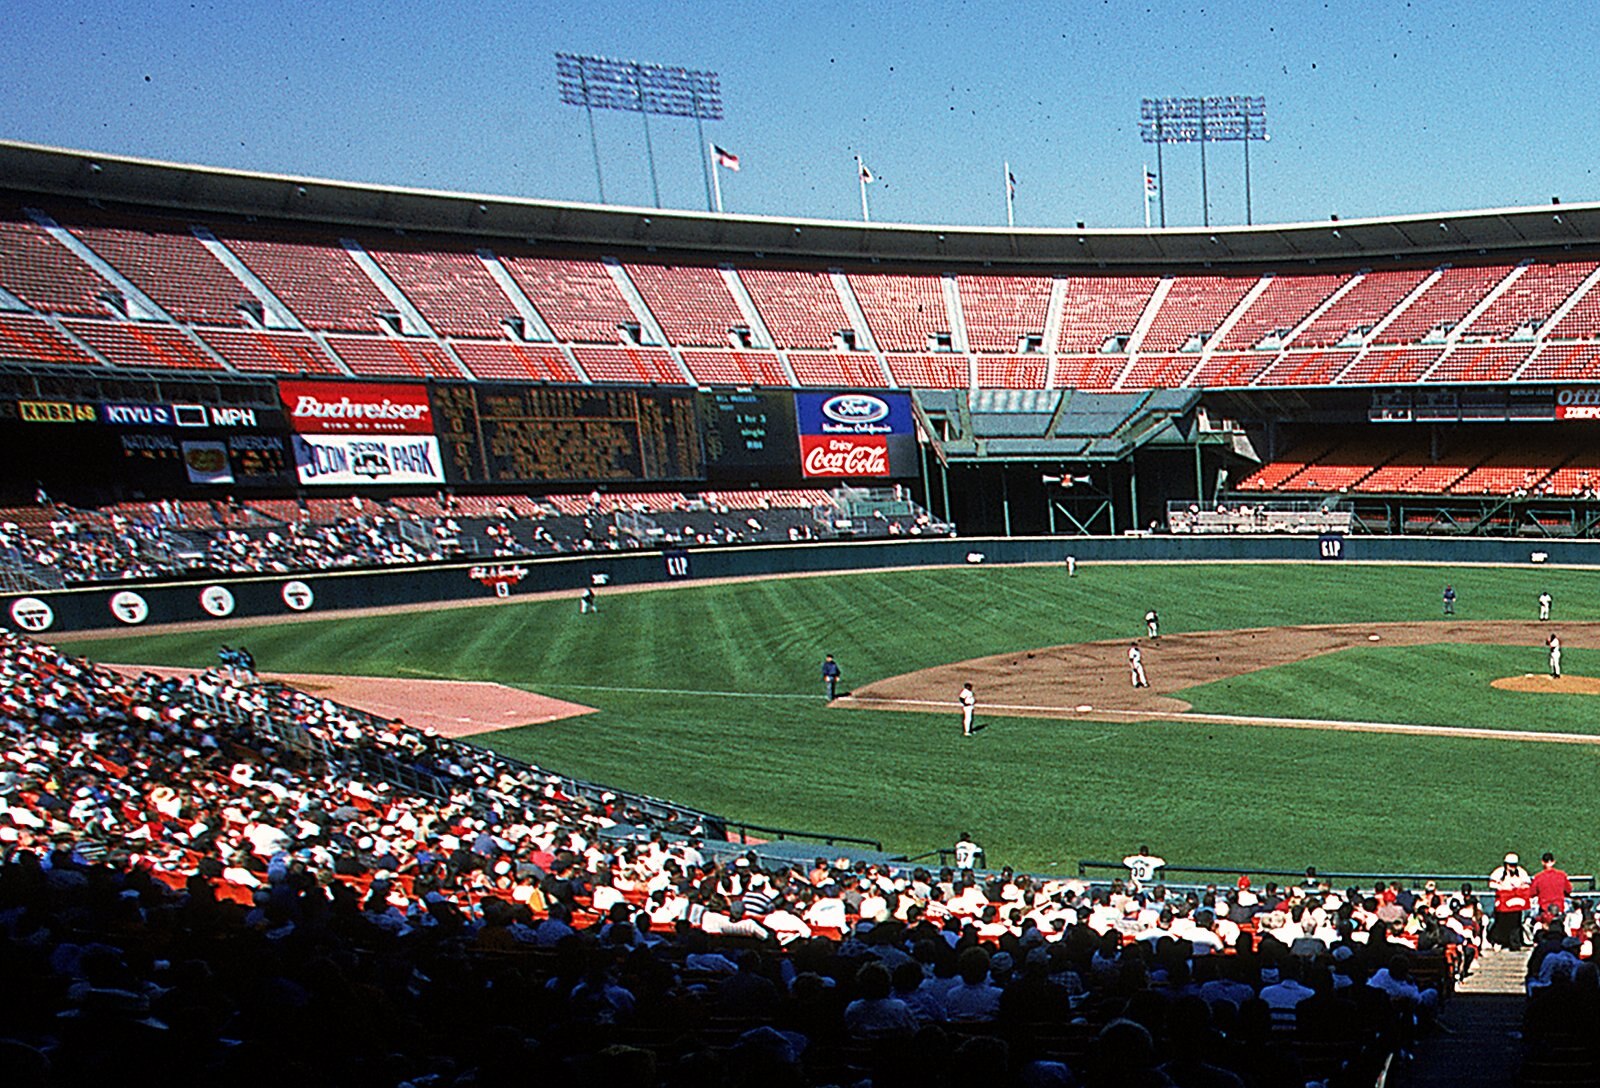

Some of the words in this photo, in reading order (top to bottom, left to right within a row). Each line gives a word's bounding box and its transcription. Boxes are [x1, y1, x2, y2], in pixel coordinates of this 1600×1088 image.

[105, 405, 154, 424] KTVU
[210, 407, 258, 426] MPH
[291, 395, 429, 420] Budweiser
[837, 399, 872, 416] Ford
[390, 441, 437, 477] PARK
[805, 446, 887, 475] Coca-Cola
[24, 615, 45, 628] NY
